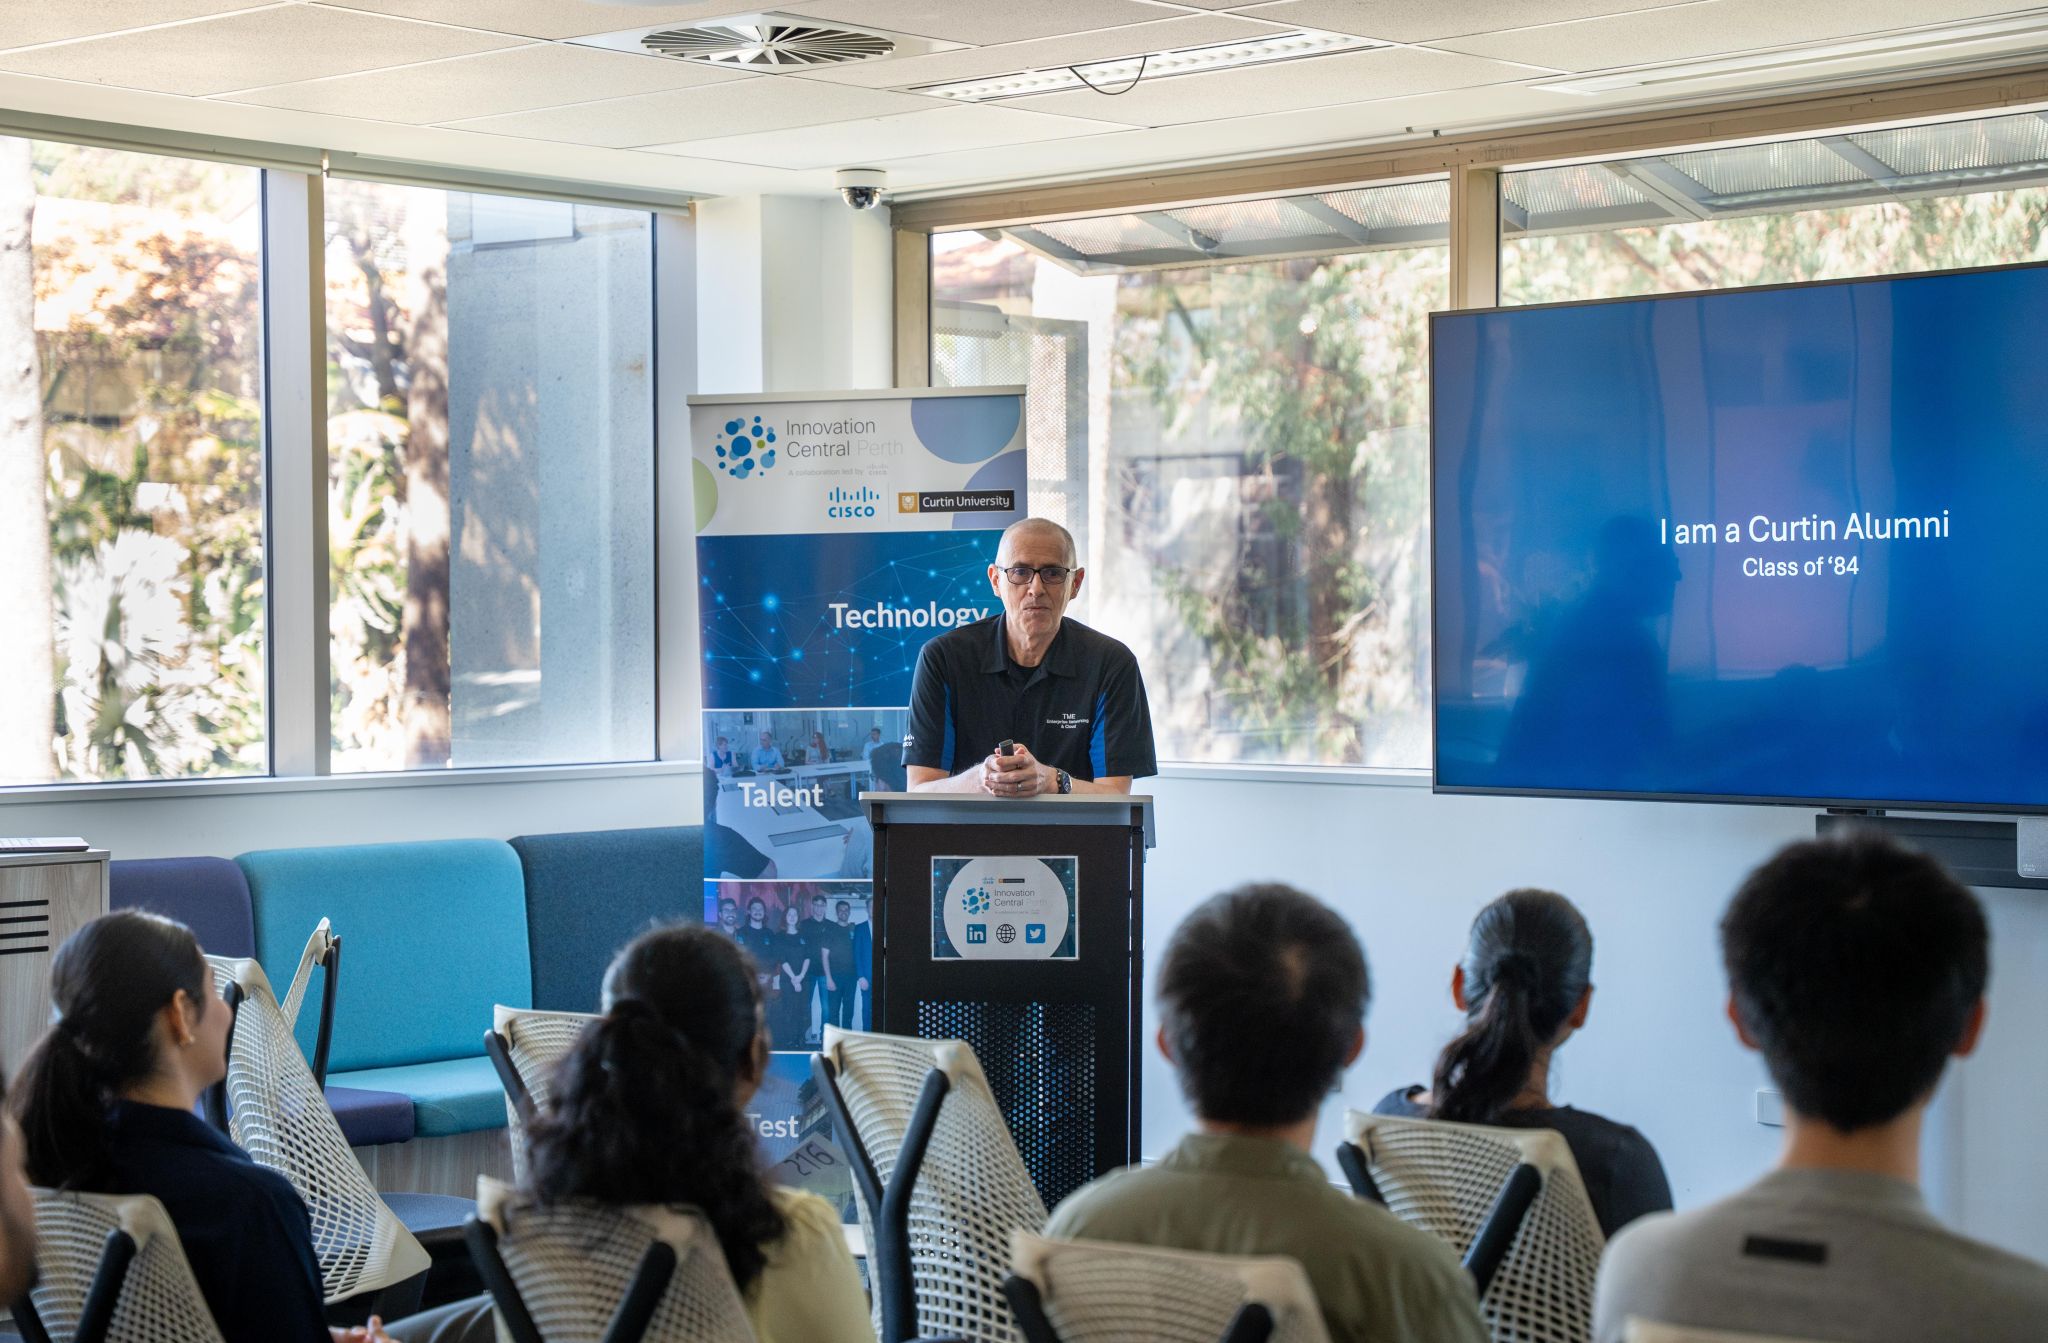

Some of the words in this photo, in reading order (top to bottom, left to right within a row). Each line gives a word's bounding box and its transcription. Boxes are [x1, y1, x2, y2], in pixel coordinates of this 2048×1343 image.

[786, 418, 876, 436] Innovation
[786, 440, 850, 458] Central
[857, 440, 904, 456] Perth
[922, 497, 955, 508] Curtin
[956, 496, 1010, 508] University
[828, 506, 875, 517] CISCO
[1660, 518, 1667, 545] I
[1674, 522, 1717, 545] am
[1724, 523, 1740, 543] a
[1748, 513, 1837, 542] Curtin
[1843, 509, 1949, 540] Alumni
[1742, 557, 1799, 577] Class
[1803, 557, 1823, 576] of
[737, 781, 824, 808] Talent
[994, 889, 1034, 897] Innovation
[994, 898, 1024, 907] Central
